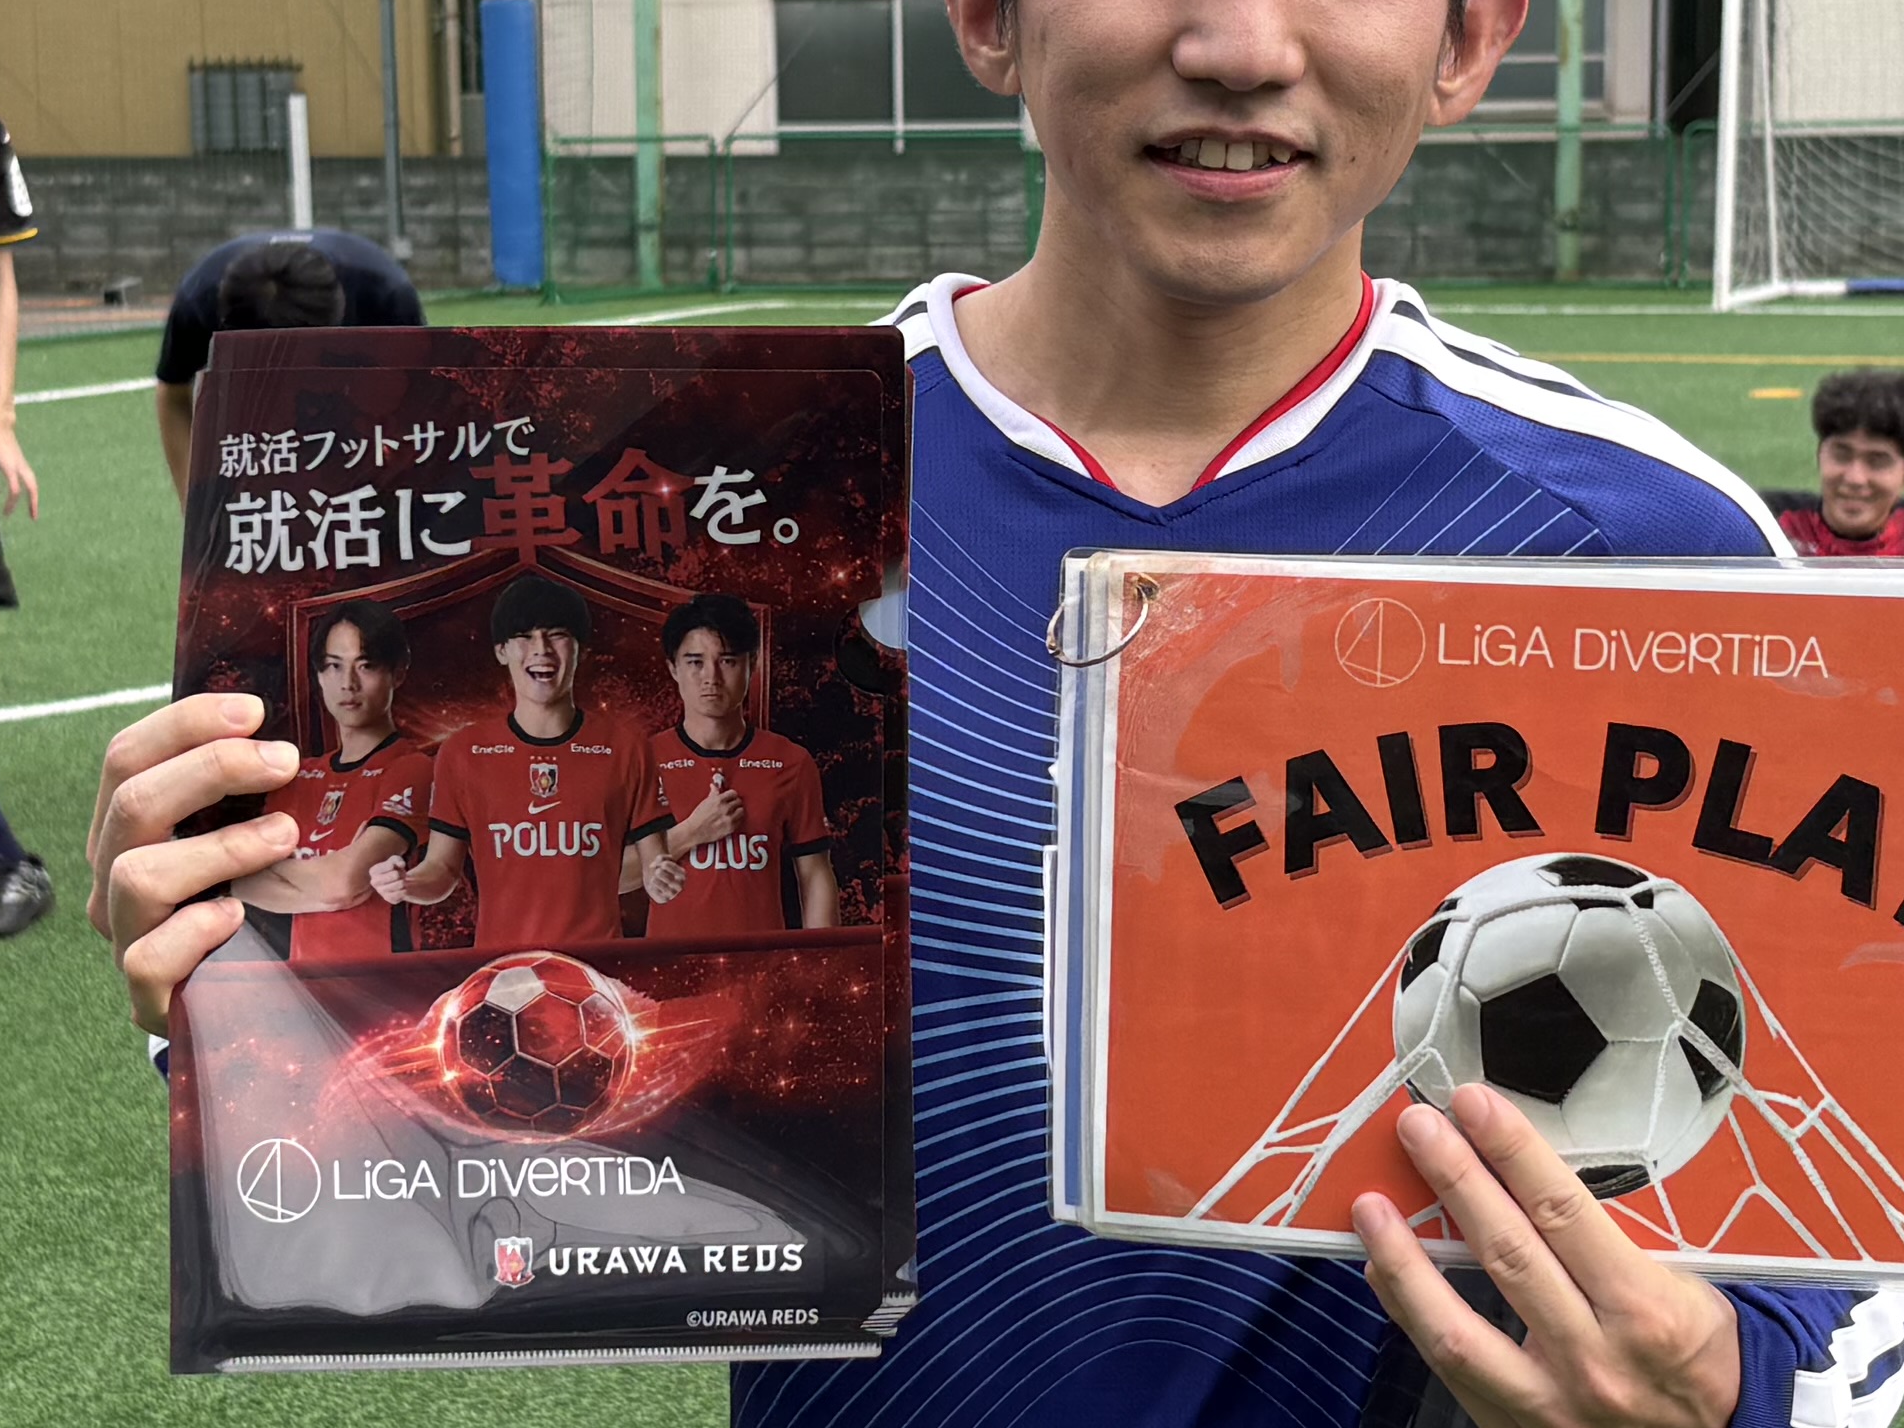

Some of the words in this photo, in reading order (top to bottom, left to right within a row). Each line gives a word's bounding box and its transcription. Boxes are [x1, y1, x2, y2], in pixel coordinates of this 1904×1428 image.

[218, 417, 536, 478] 就活フットサルで
[224, 447, 800, 574] 就活に革命を。
[1174, 721, 1545, 910] FAIR
[488, 821, 602, 859] POLUS
[689, 834, 769, 871] OLUS
[548, 1246, 687, 1275] URAWA
[703, 1244, 804, 1272] REDS
[771, 1308, 819, 1326] REDS
